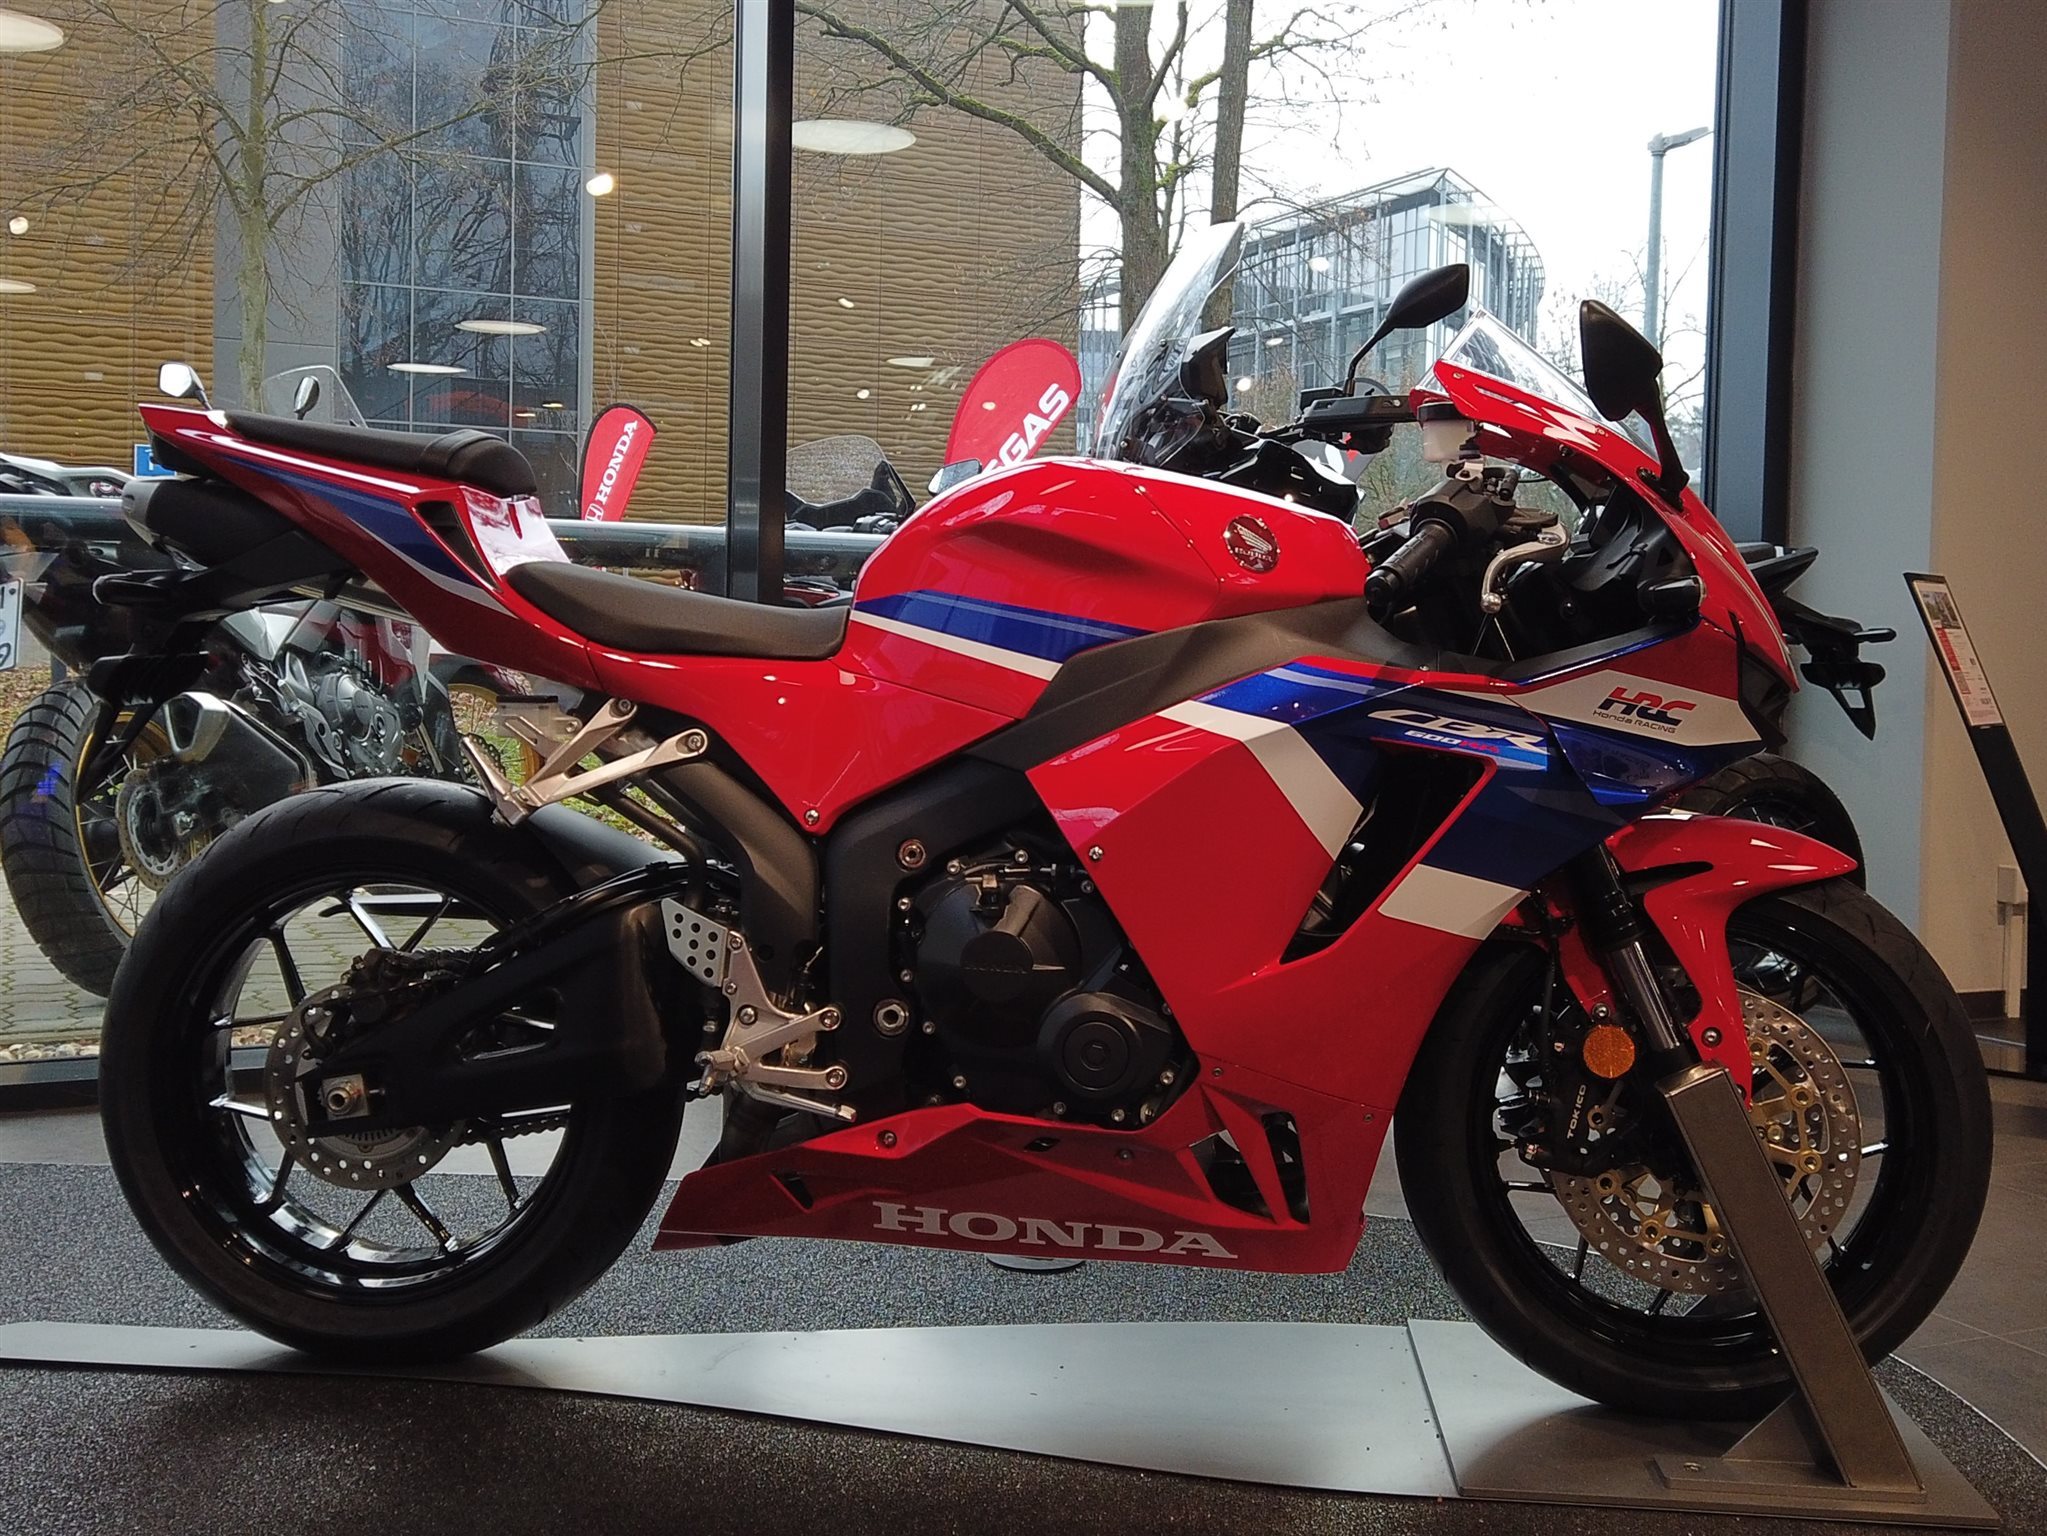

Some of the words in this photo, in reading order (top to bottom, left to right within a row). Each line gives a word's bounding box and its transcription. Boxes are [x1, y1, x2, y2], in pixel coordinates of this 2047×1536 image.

[595, 420, 638, 505] HONDA
[1367, 708, 1552, 755] CBR
[1592, 709, 1633, 724] Honda
[1634, 719, 1677, 734] RACING
[1598, 686, 1697, 727] HRC
[1566, 1084, 1587, 1139] TOKICO
[872, 1201, 1238, 1259] HONDA
